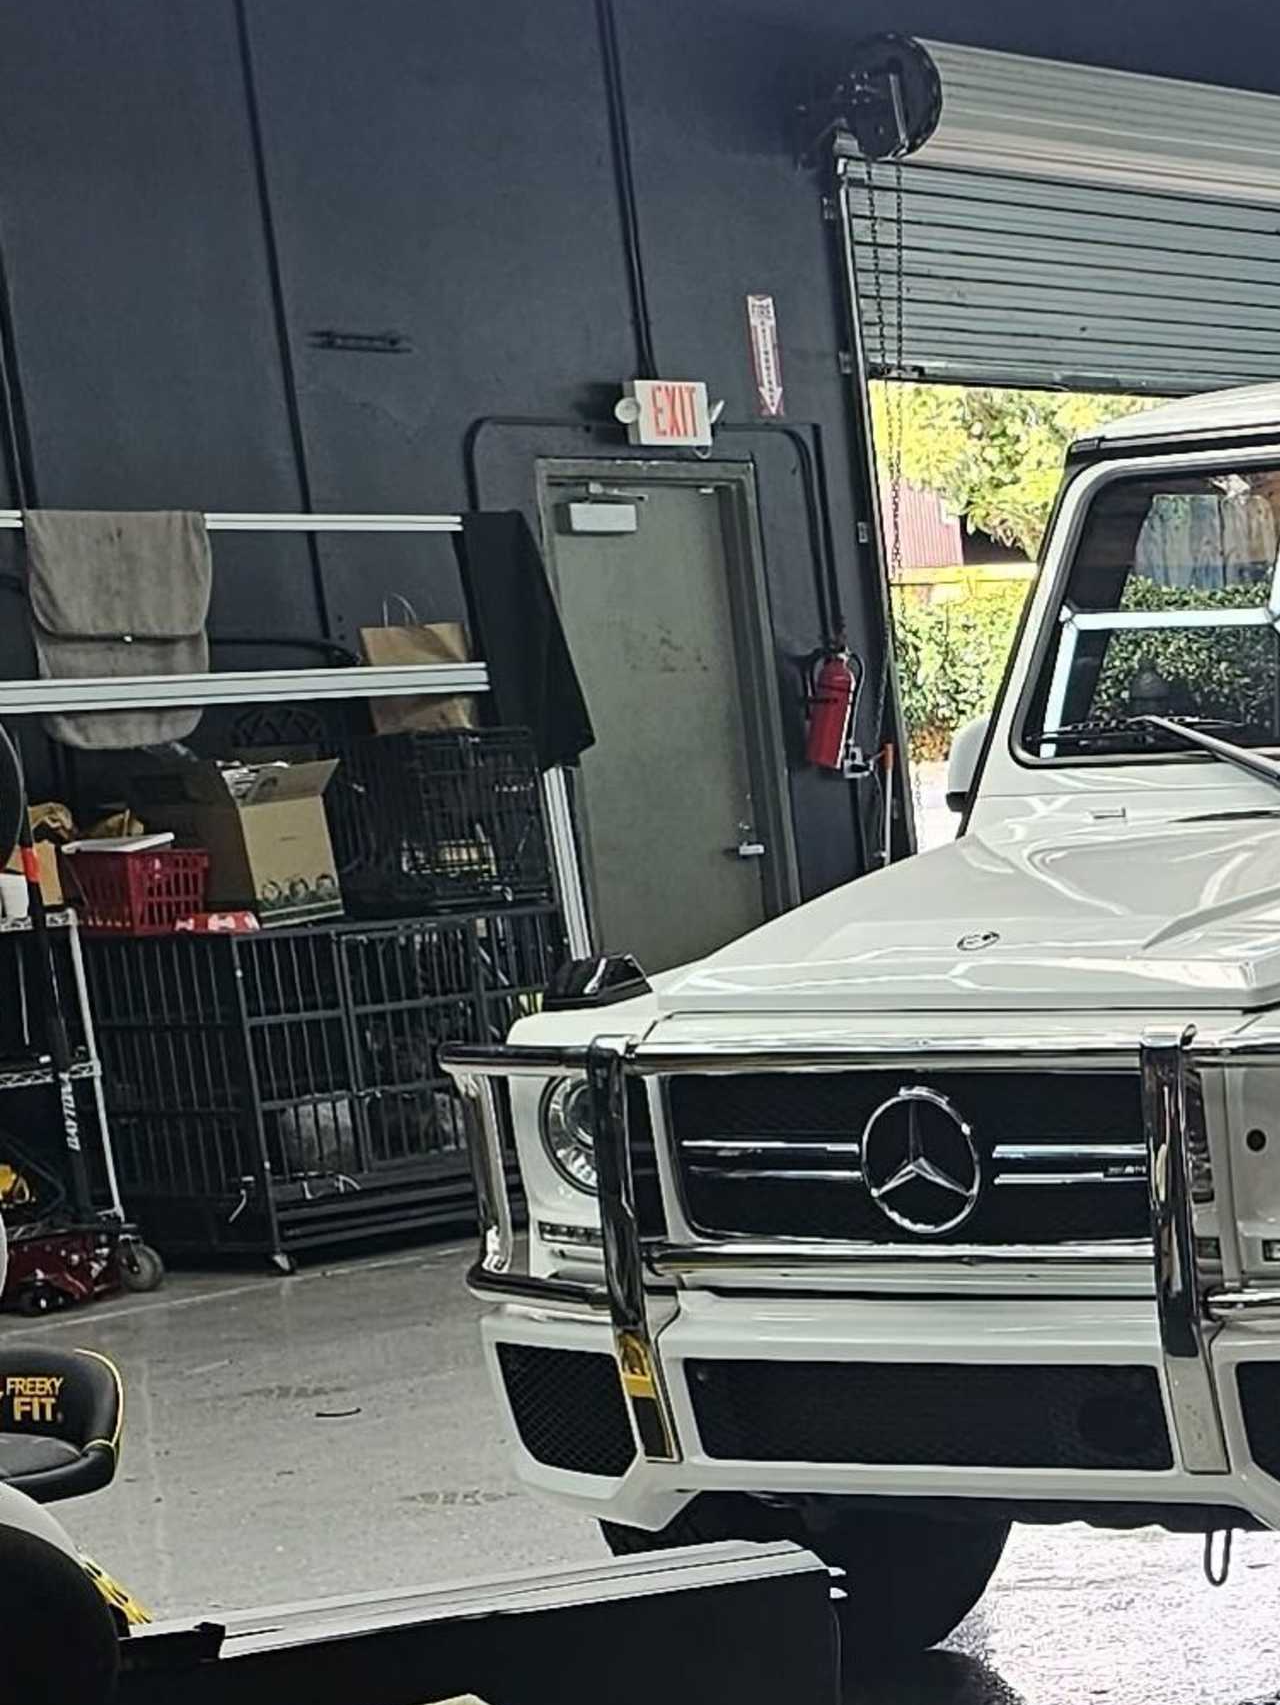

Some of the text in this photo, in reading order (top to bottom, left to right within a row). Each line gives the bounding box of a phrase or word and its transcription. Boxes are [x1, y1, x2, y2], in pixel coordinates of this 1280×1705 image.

[652, 385, 698, 437] EXIT
[6, 1376, 64, 1395] FREEKY
[13, 1396, 56, 1421] FIT
